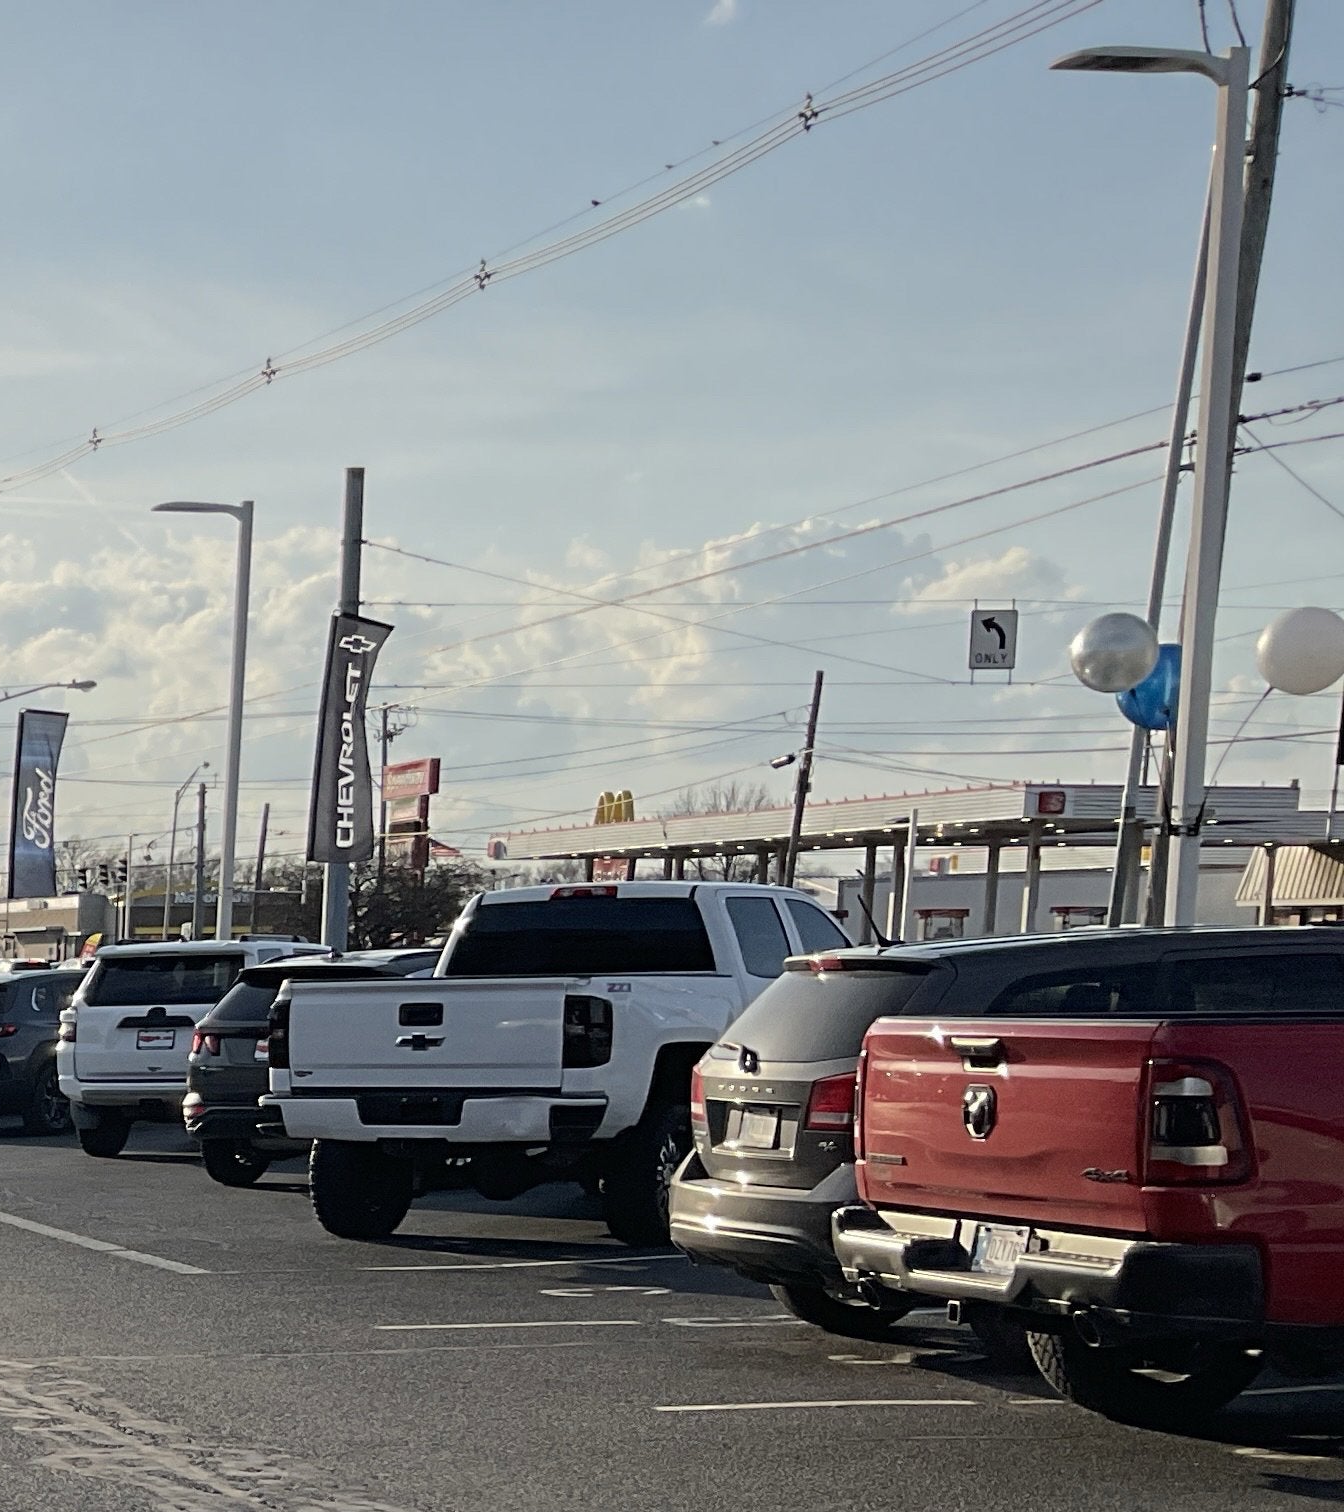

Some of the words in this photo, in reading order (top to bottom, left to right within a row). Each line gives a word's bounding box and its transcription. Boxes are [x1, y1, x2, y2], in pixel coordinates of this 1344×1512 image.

[974, 652, 1008, 664] ONLY
[335, 662, 363, 848] CHEVROLET
[22, 766, 53, 849] Ford
